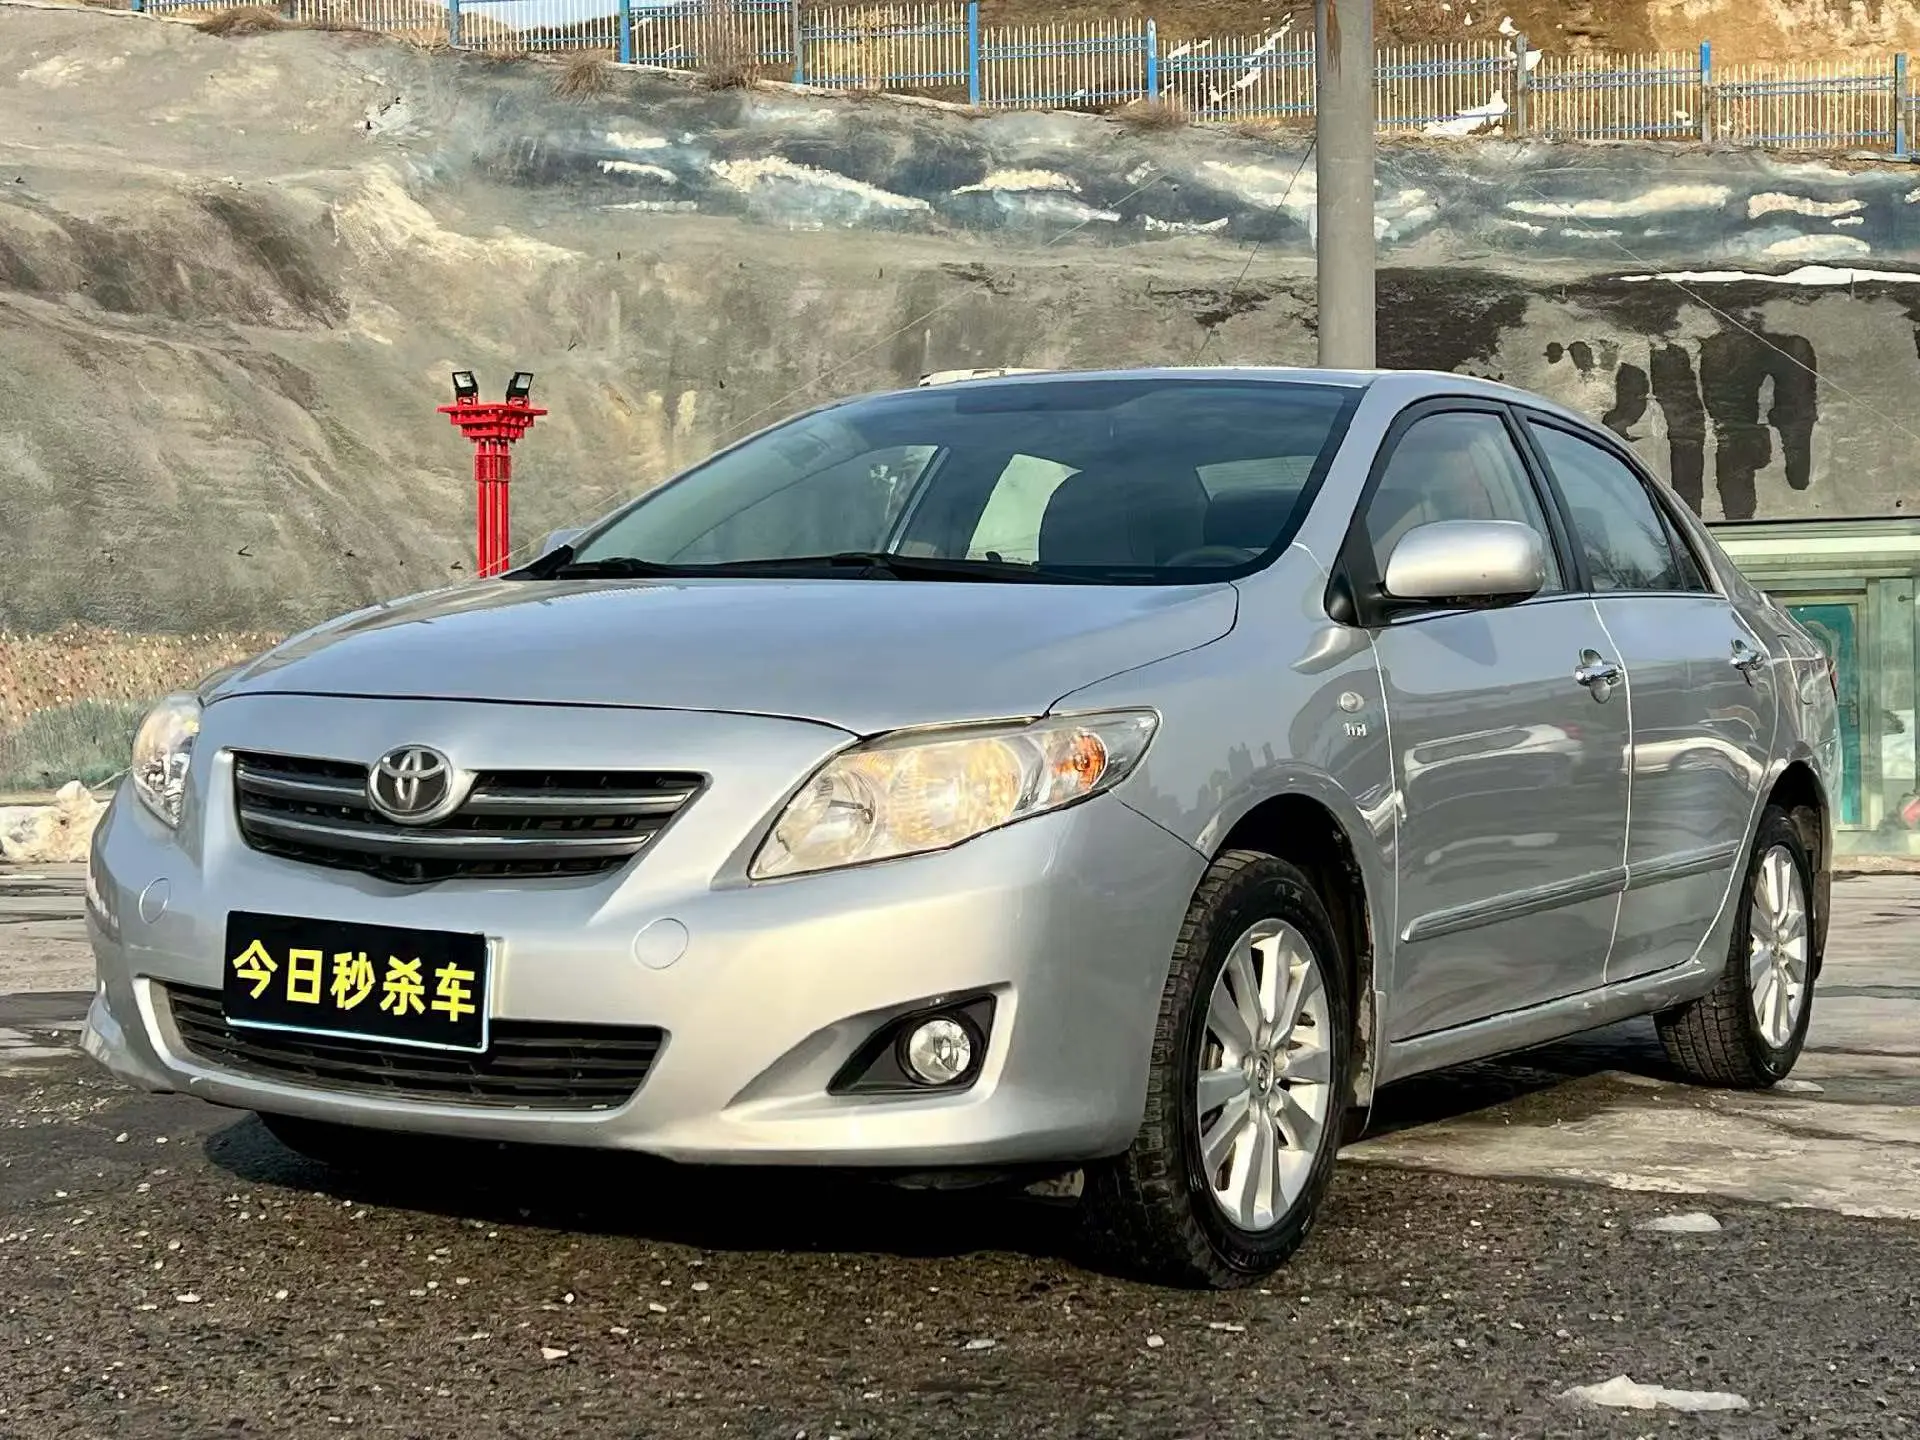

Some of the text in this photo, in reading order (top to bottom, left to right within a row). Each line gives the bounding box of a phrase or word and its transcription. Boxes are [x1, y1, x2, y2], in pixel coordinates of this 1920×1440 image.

[232, 939, 476, 1022] 今日秒杀车
